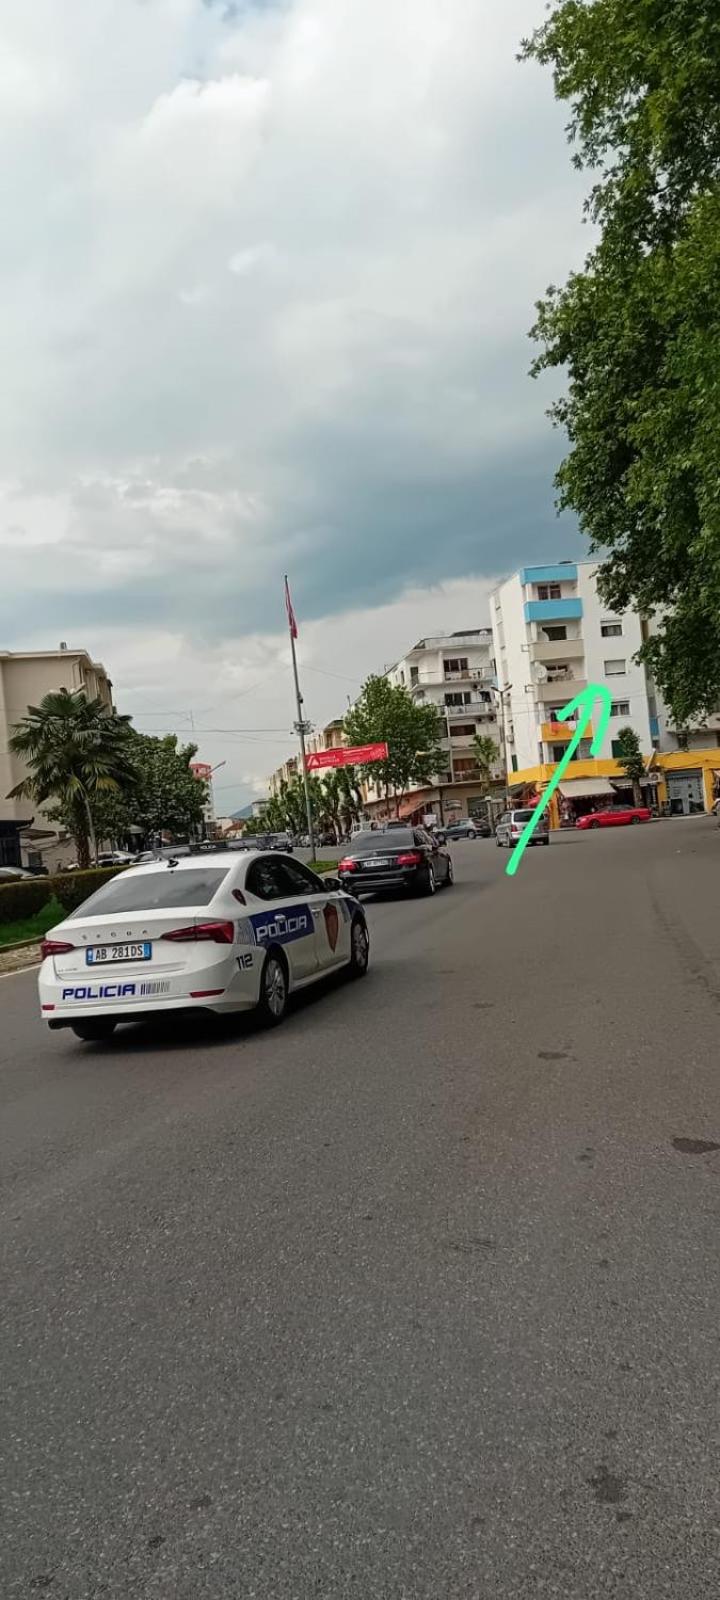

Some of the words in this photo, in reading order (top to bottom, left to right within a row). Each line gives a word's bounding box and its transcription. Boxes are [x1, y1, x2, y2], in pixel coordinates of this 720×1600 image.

[255, 915, 307, 942] POLICIA
[95, 948, 107, 960] AB
[112, 945, 143, 959] 281DS
[236, 953, 254, 970] 112
[62, 983, 136, 1000] POLICIA
